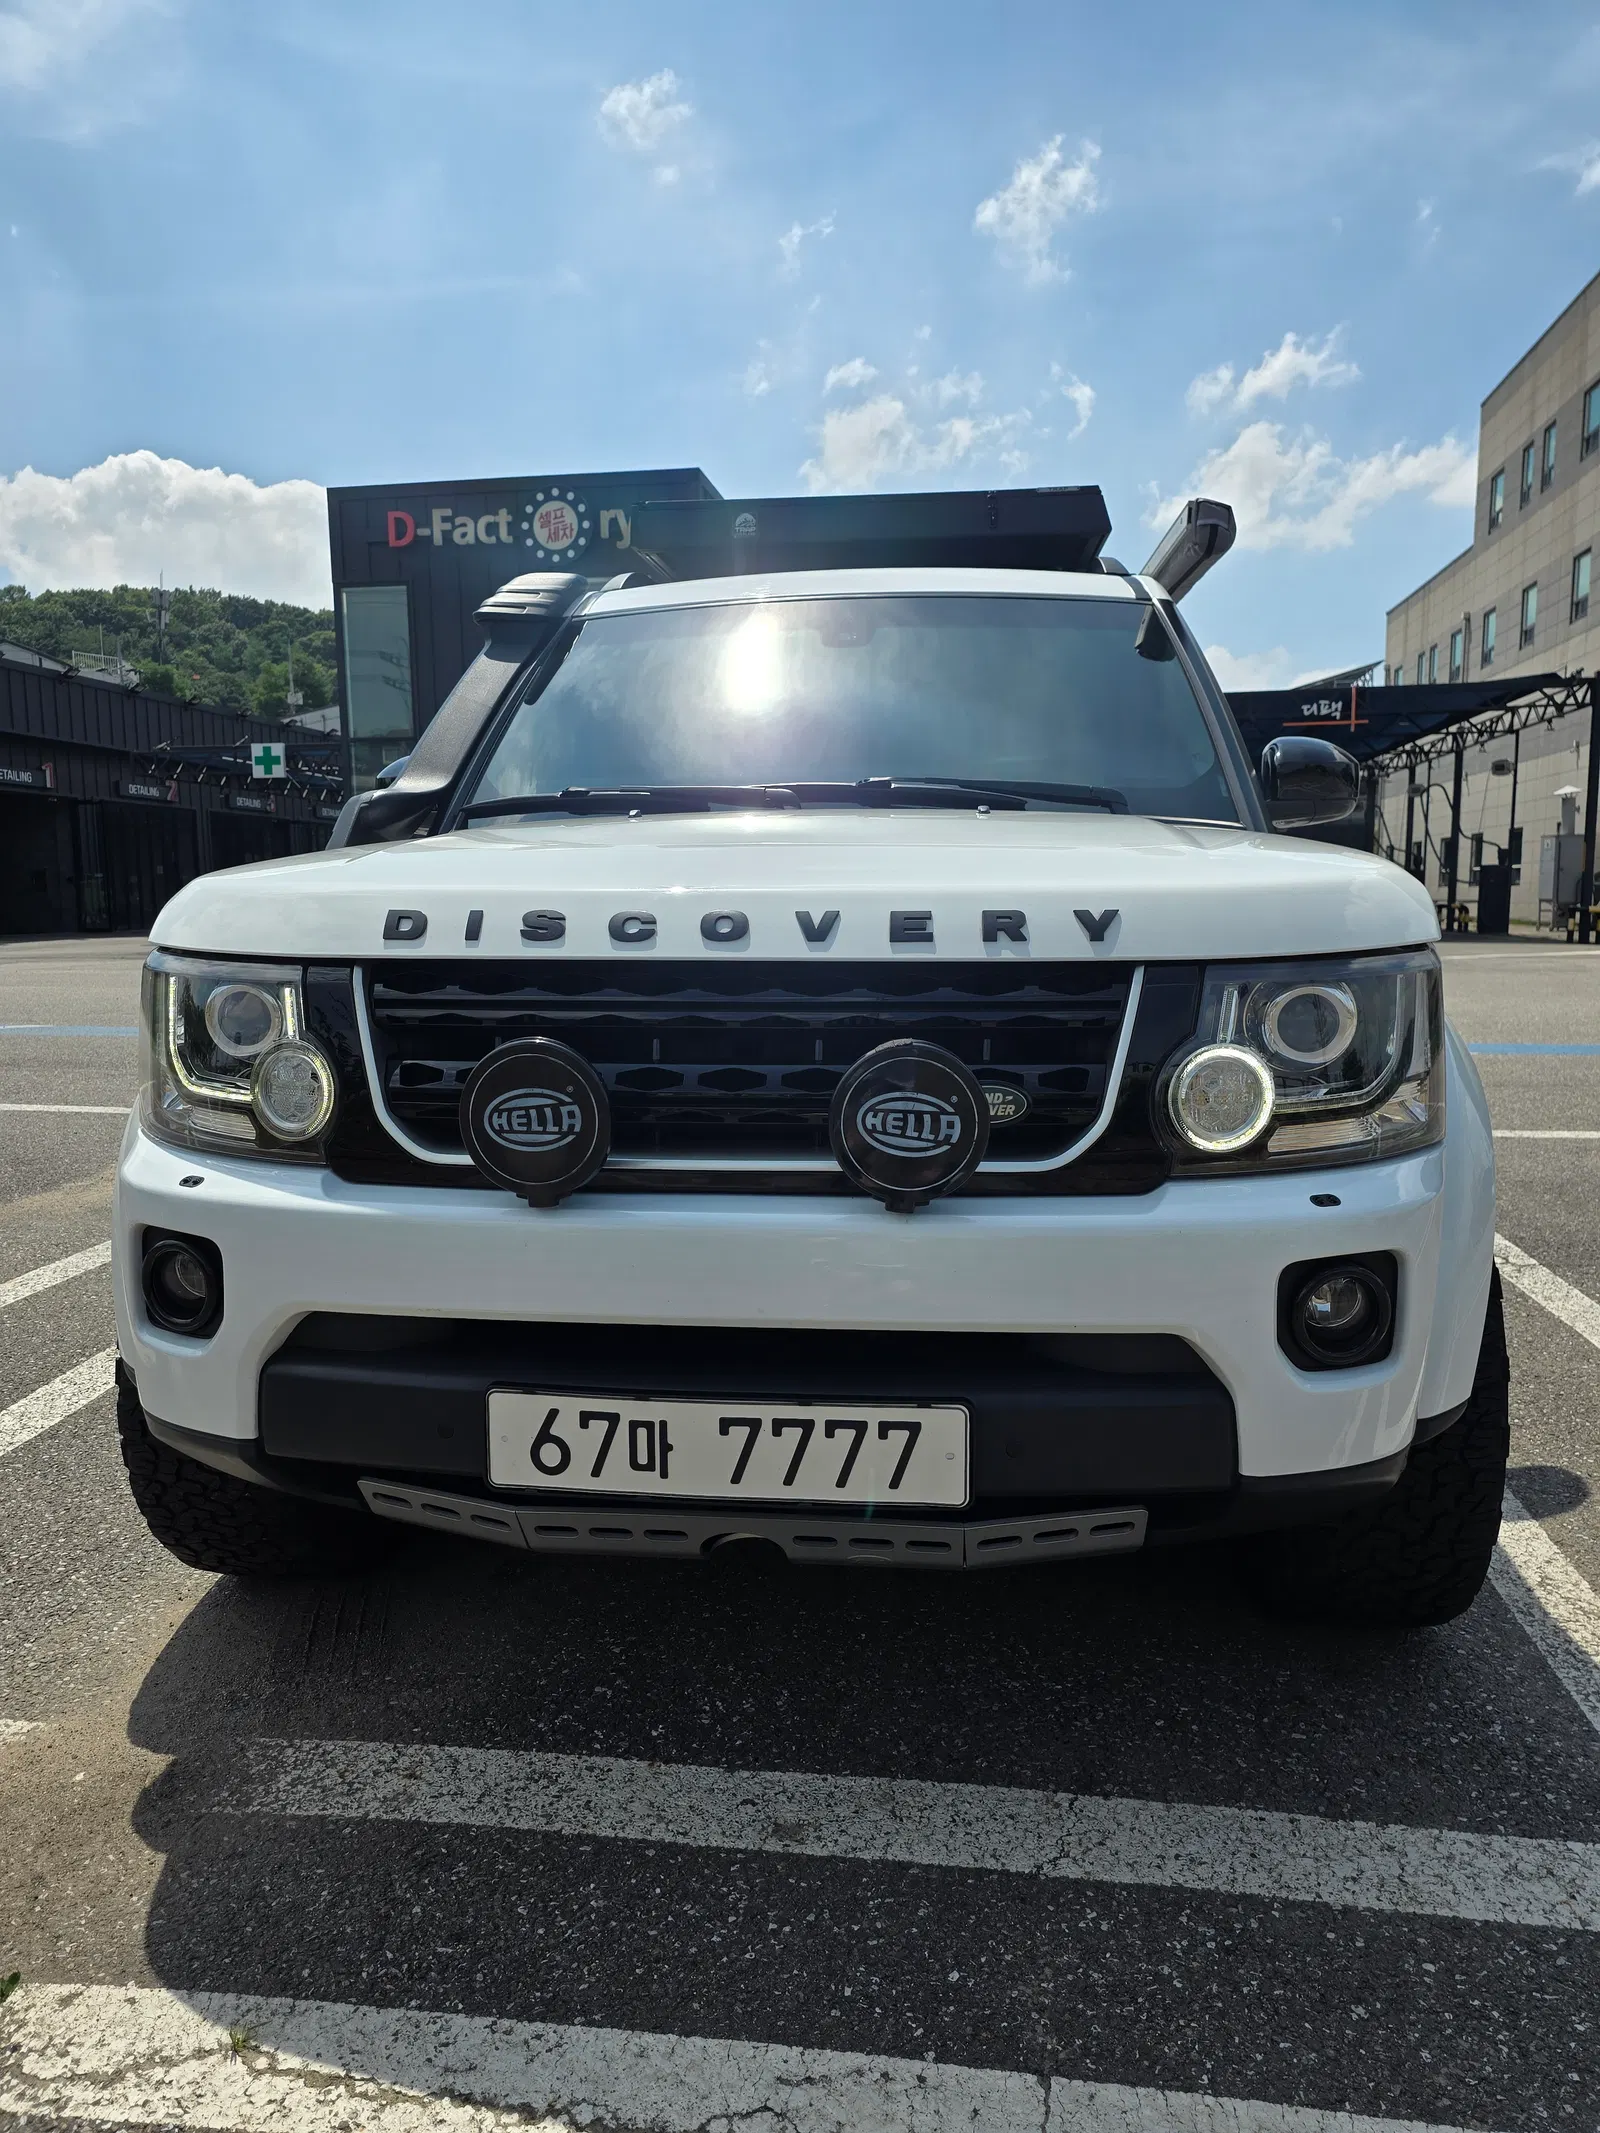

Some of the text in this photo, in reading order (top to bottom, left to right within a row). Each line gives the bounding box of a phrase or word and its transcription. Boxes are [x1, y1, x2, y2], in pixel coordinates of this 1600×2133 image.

[537, 506, 566, 529] 셀프
[546, 522, 575, 545] 세차
[1301, 699, 1343, 721] 디팩
[0, 761, 55, 789] ETAILING 1
[128, 779, 179, 802] DETAILING 2
[382, 908, 1120, 943] DISCOVERY
[985, 1092, 1003, 1104] ND
[492, 1102, 581, 1133] HELLA
[989, 1104, 1016, 1116] VER
[866, 1109, 960, 1144] HELLA
[529, 1407, 923, 1491] 67마 7777
